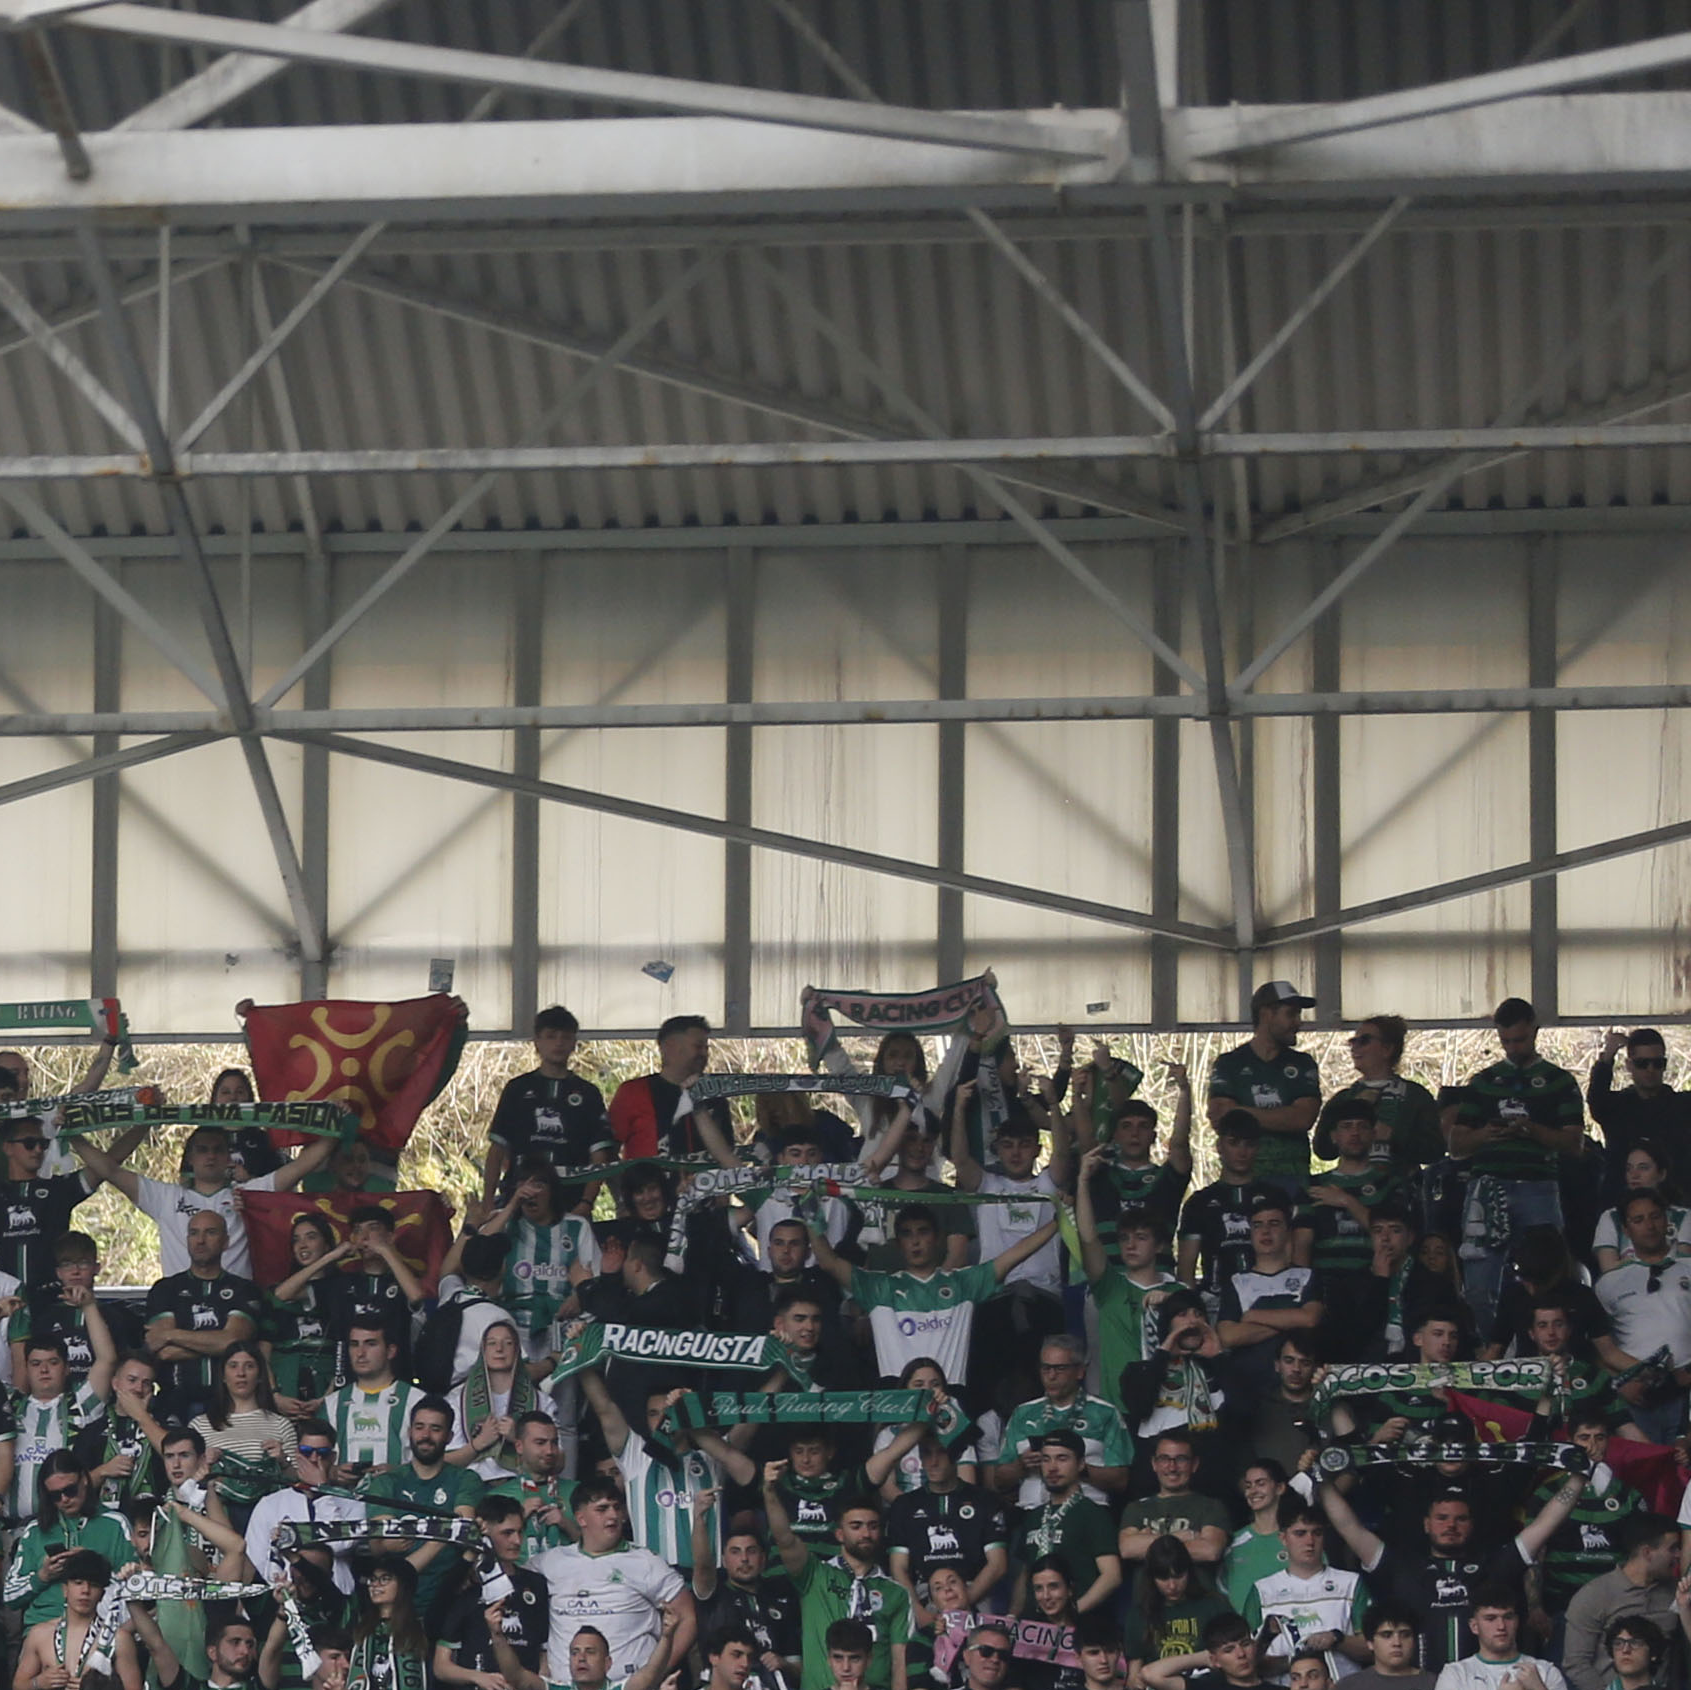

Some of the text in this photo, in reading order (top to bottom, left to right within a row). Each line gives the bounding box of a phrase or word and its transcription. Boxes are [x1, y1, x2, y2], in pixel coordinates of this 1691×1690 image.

[16, 1004, 76, 1021] RACING
[849, 1001, 940, 1023] RACING
[66, 1103, 133, 1127] ENOS
[191, 1103, 241, 1122] UNA
[791, 1162, 862, 1182] MALD
[601, 1323, 766, 1364] RACINGUISTA
[1470, 1362, 1543, 1387] POR
[707, 1391, 917, 1419] Real Racing Club
[1002, 1618, 1075, 1651] ACING
